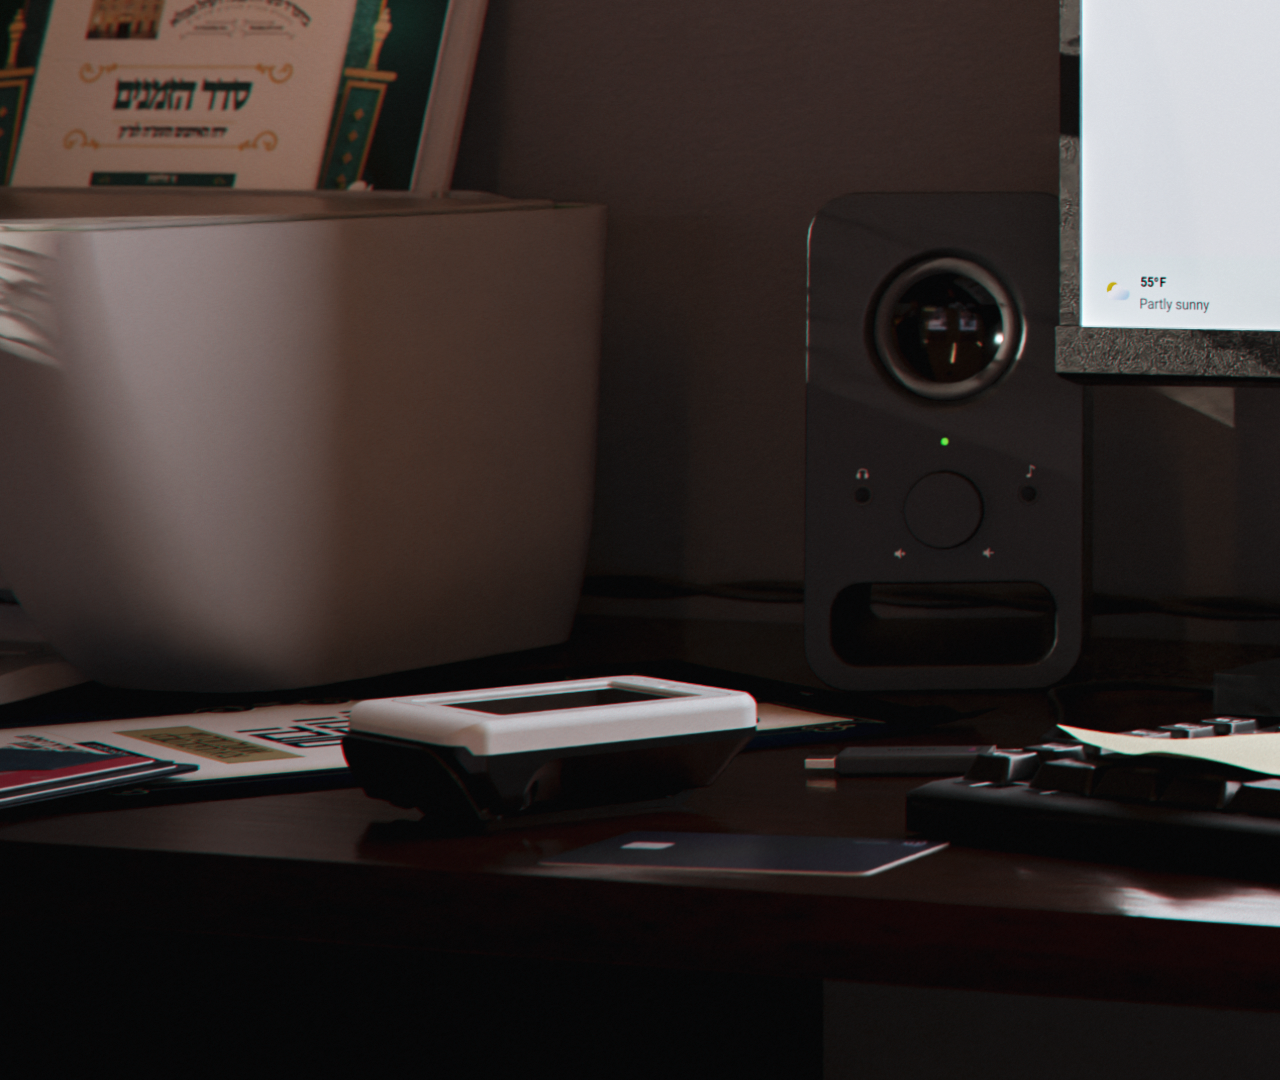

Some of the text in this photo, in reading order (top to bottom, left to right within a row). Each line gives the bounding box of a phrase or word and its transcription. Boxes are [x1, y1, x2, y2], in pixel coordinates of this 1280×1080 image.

[113, 77, 254, 111] סדר הזמנים
[1140, 276, 1167, 289] 55°F
[1139, 297, 1210, 313] Partly sunny
